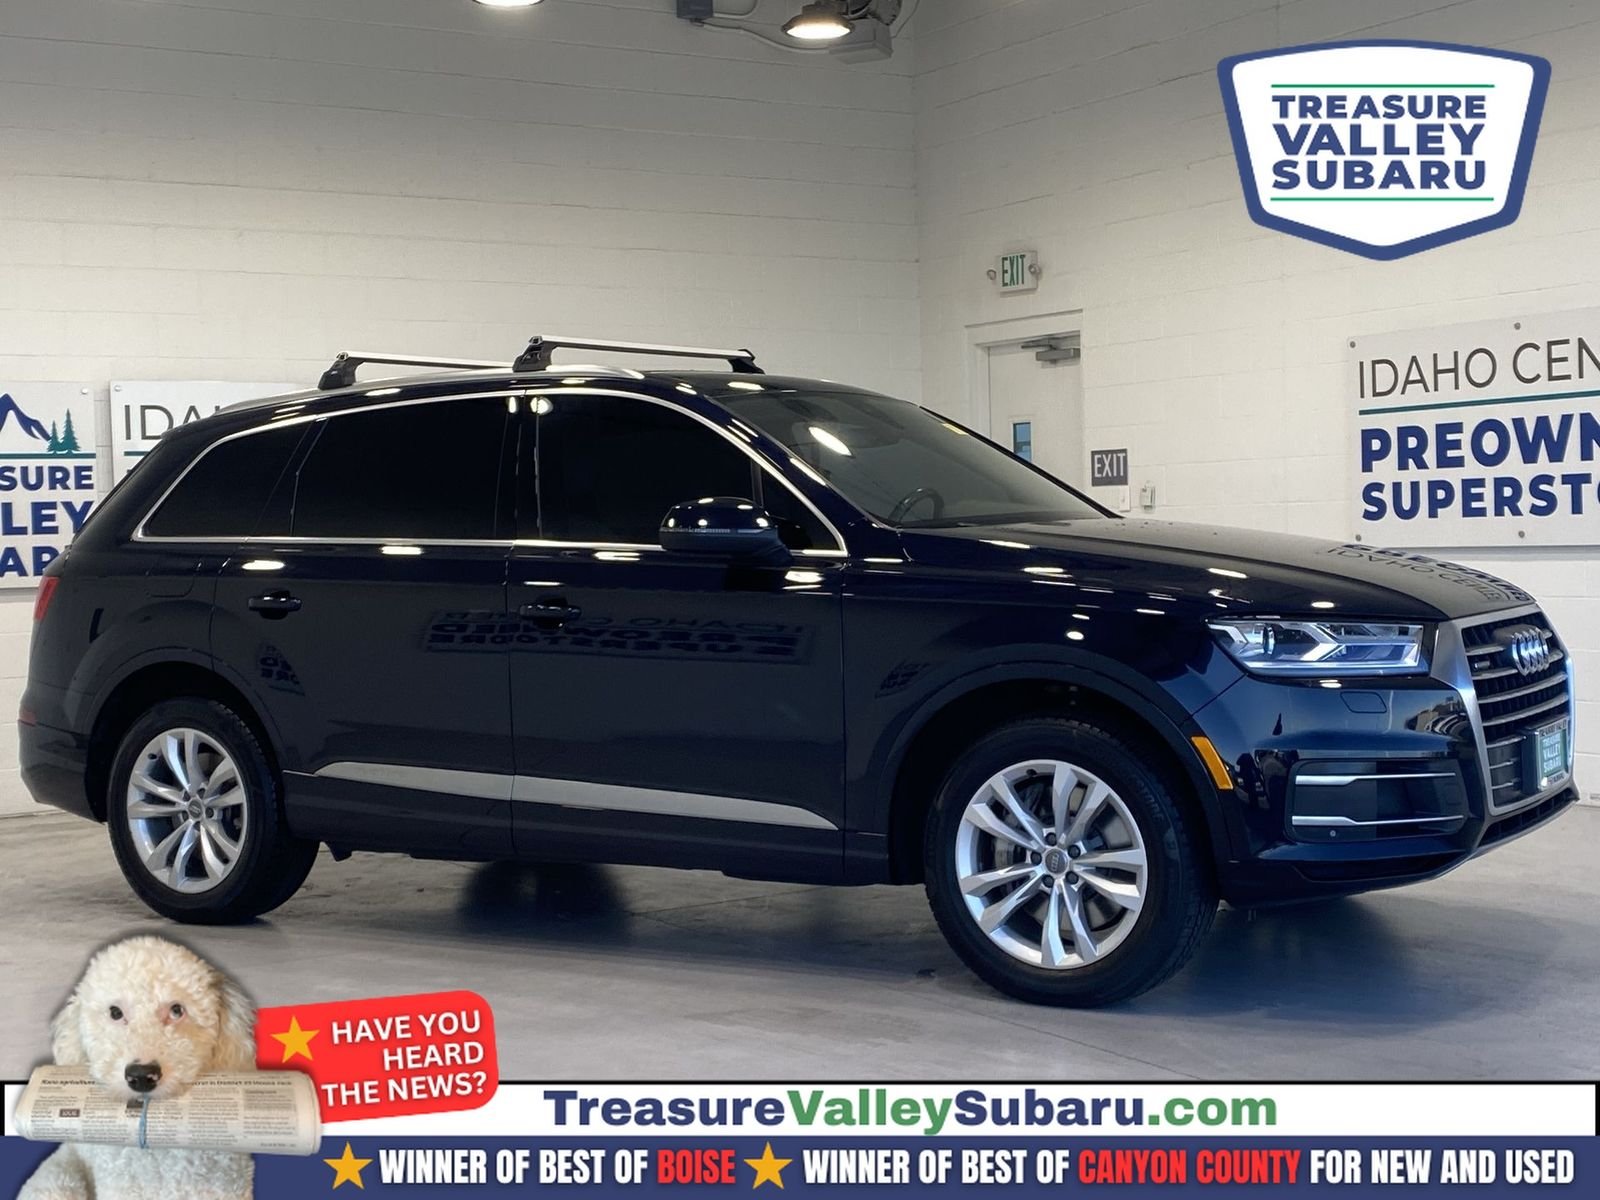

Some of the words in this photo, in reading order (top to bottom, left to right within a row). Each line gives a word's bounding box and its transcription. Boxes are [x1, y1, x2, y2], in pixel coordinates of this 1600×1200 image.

[1001, 254, 1026, 287] EXIT
[1358, 348, 1497, 399] IDAHO
[124, 404, 220, 440] IDA
[1361, 412, 1600, 473] PREOWN
[1094, 453, 1126, 478] EXIT
[1362, 473, 1600, 522] SUPERST
